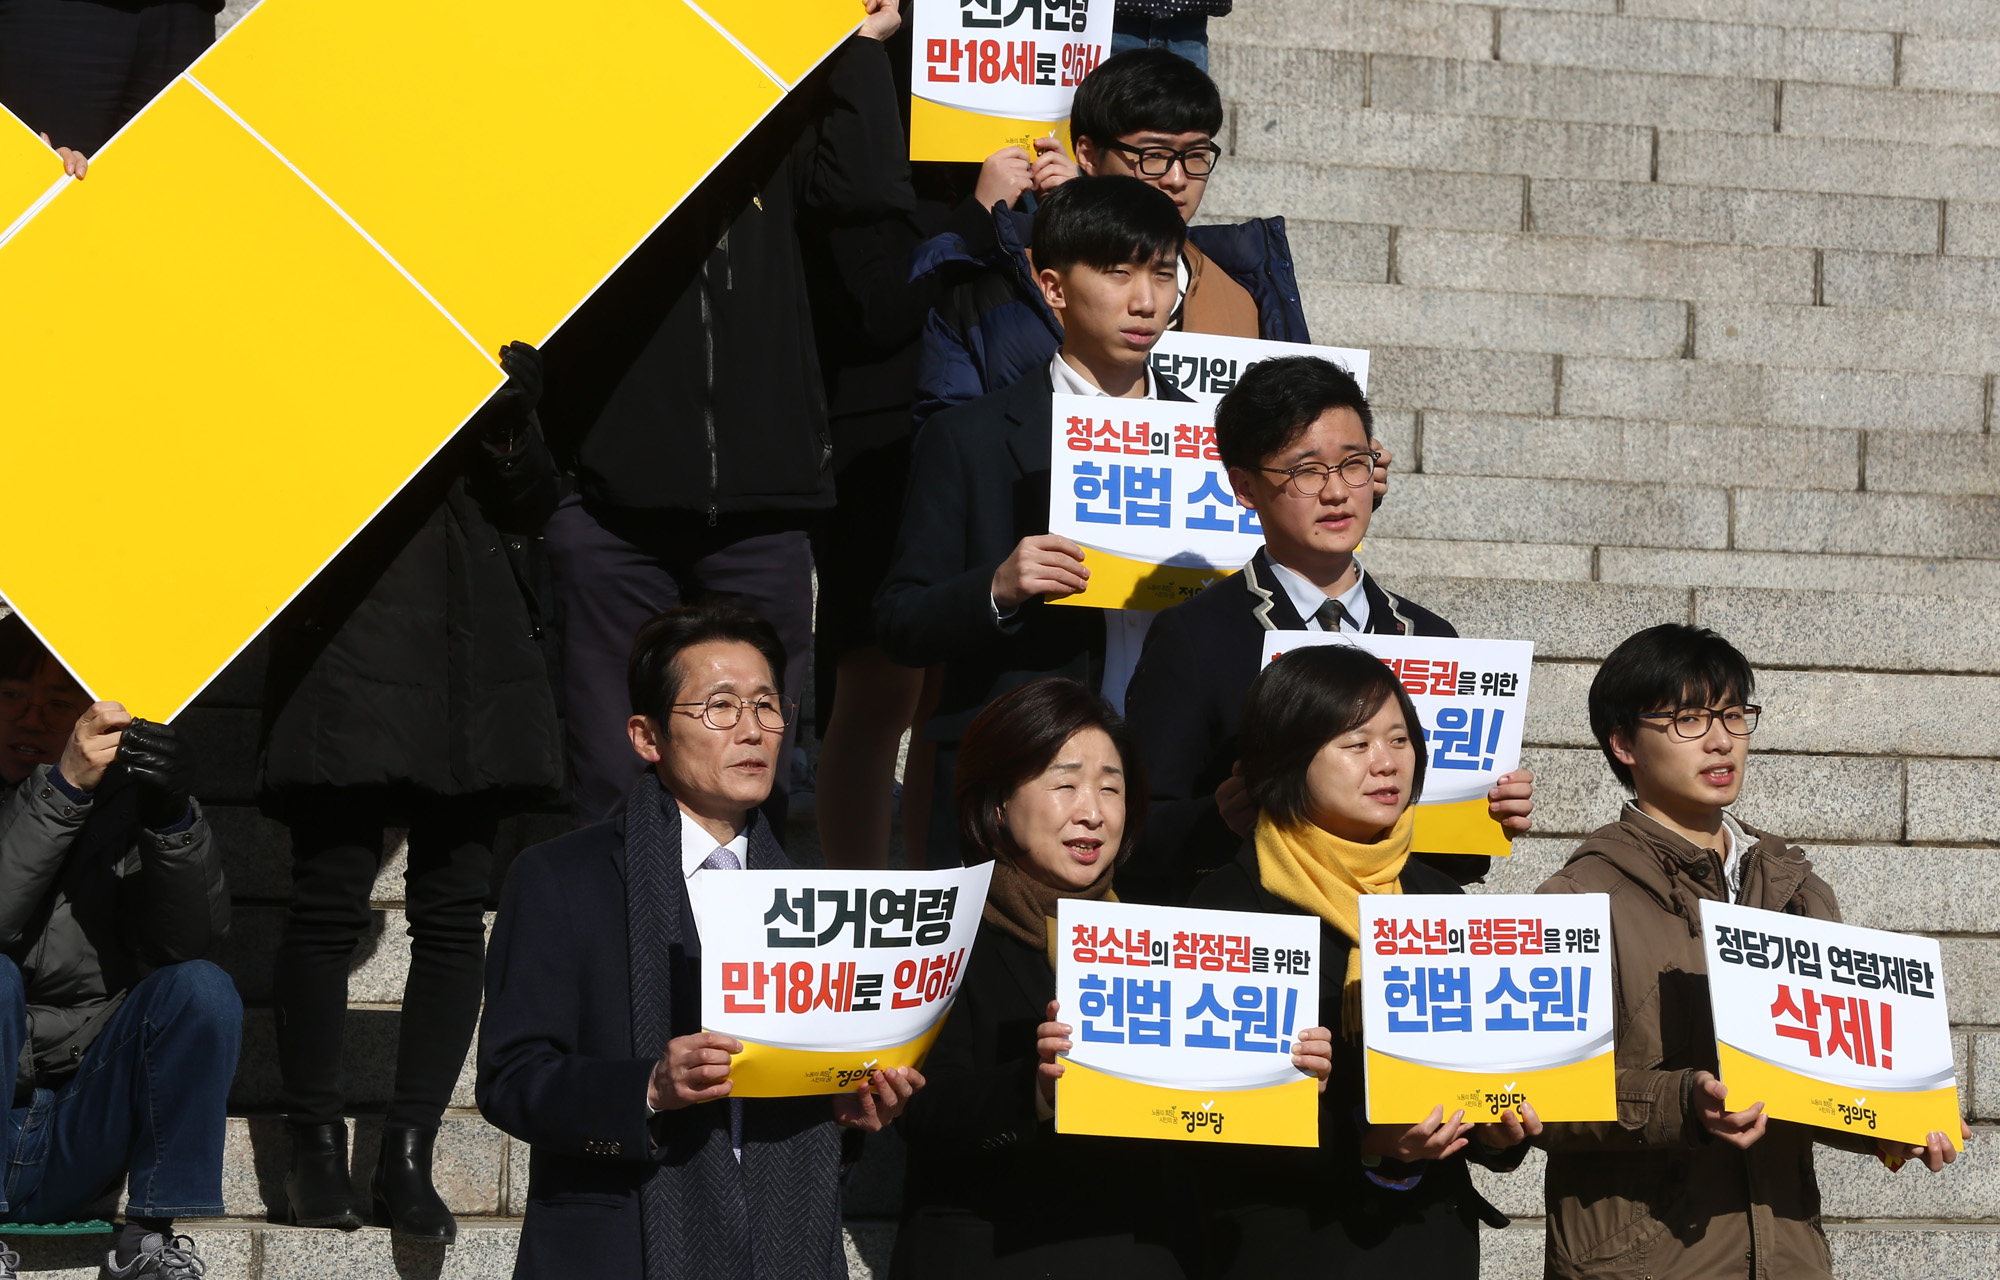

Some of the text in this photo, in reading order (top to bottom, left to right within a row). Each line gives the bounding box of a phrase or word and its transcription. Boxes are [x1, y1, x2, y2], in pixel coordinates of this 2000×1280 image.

[927, 39, 1056, 86] 만18세로
[1146, 352, 1237, 393] 당가입
[1066, 415, 1223, 461] 청소년의 참정
[1072, 460, 1172, 528] 헌법
[1480, 672, 1518, 697] 위한
[1412, 705, 1504, 771] 원!
[764, 886, 959, 948] 선거연령
[1373, 917, 1600, 955] 청소년의 평등권을 위한
[1072, 924, 1310, 975] 청소년의 참정권을 위한
[1715, 924, 1935, 999] 정당가입 연령제한
[721, 947, 965, 1014] 만18세로 인하!
[1383, 966, 1591, 1032] 헌법 소원!
[1078, 973, 1298, 1054] 헌법 소원!
[1770, 983, 1892, 1071] 삭제!
[1181, 1111, 1224, 1135] 정의당
[1485, 1093, 1526, 1115] 정의당
[1838, 1104, 1877, 1130] 정의당
